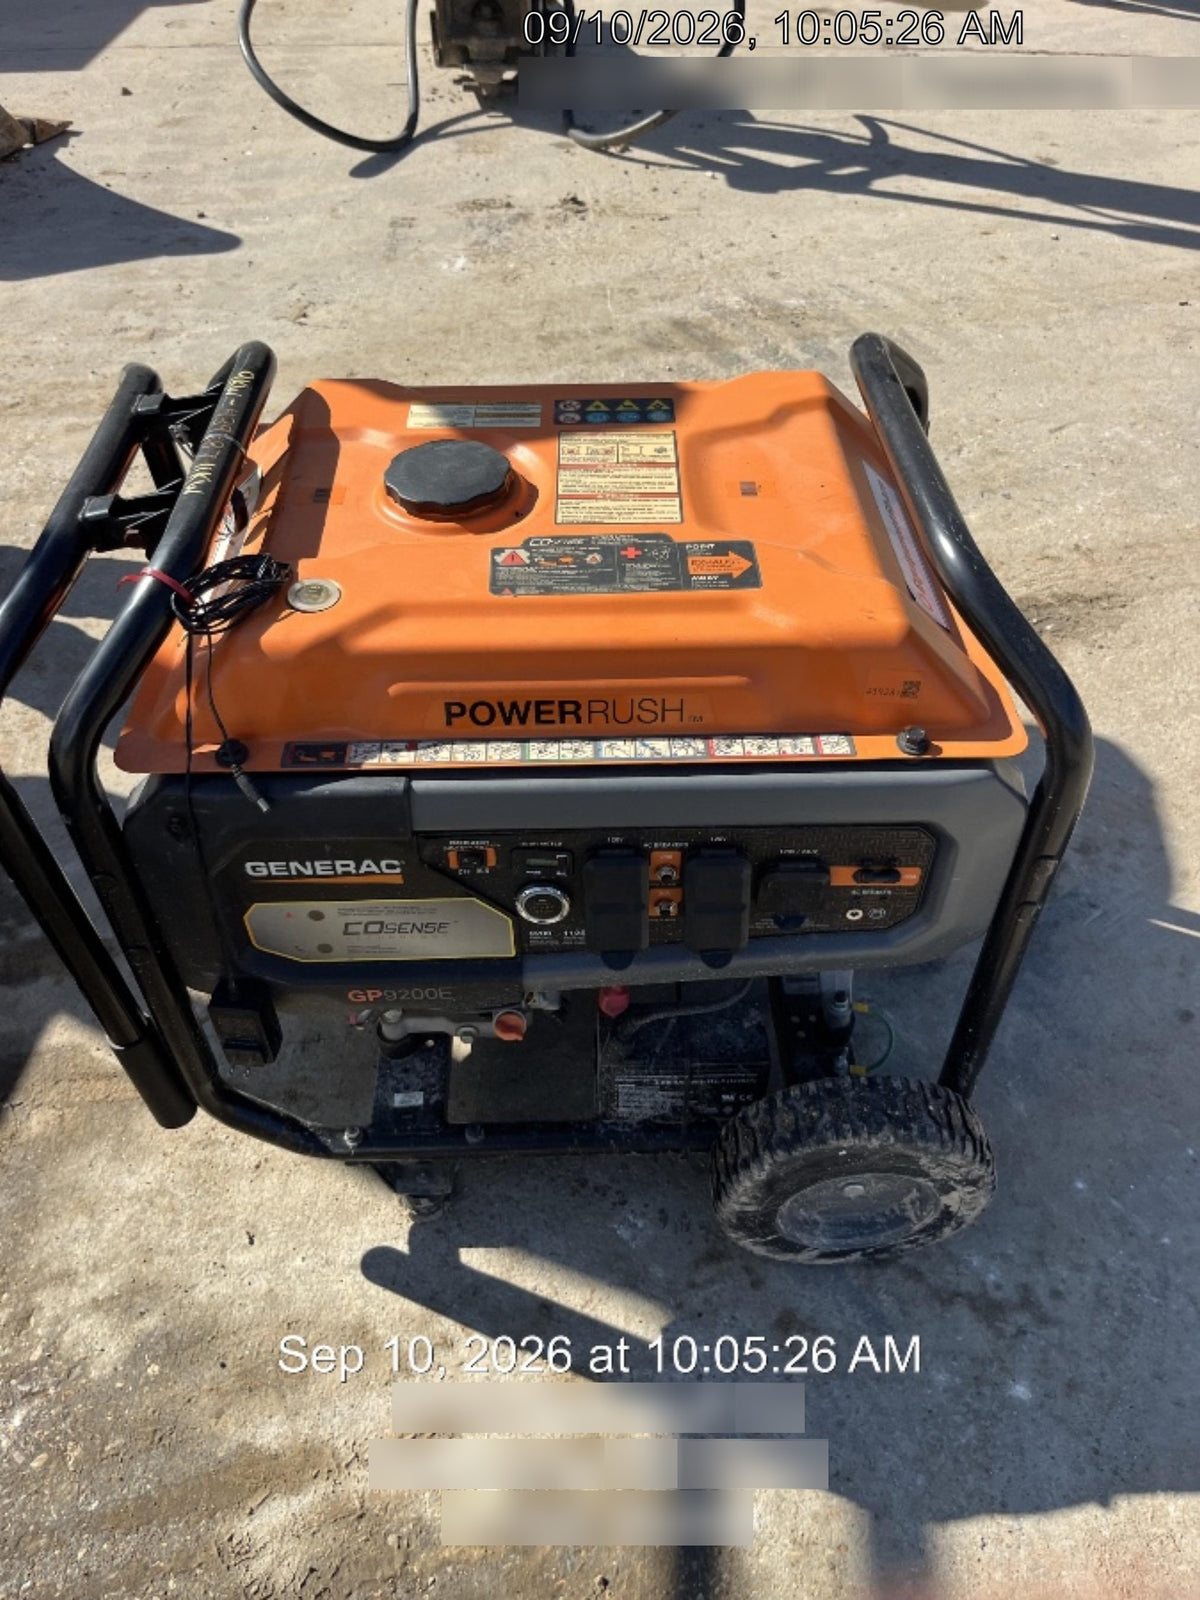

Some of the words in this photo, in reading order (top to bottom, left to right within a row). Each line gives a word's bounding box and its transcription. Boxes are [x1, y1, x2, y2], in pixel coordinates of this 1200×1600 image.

[444, 698, 684, 726] POWERRUSH
[244, 859, 402, 878] GENERAC
[347, 987, 453, 1003] GP9200E
